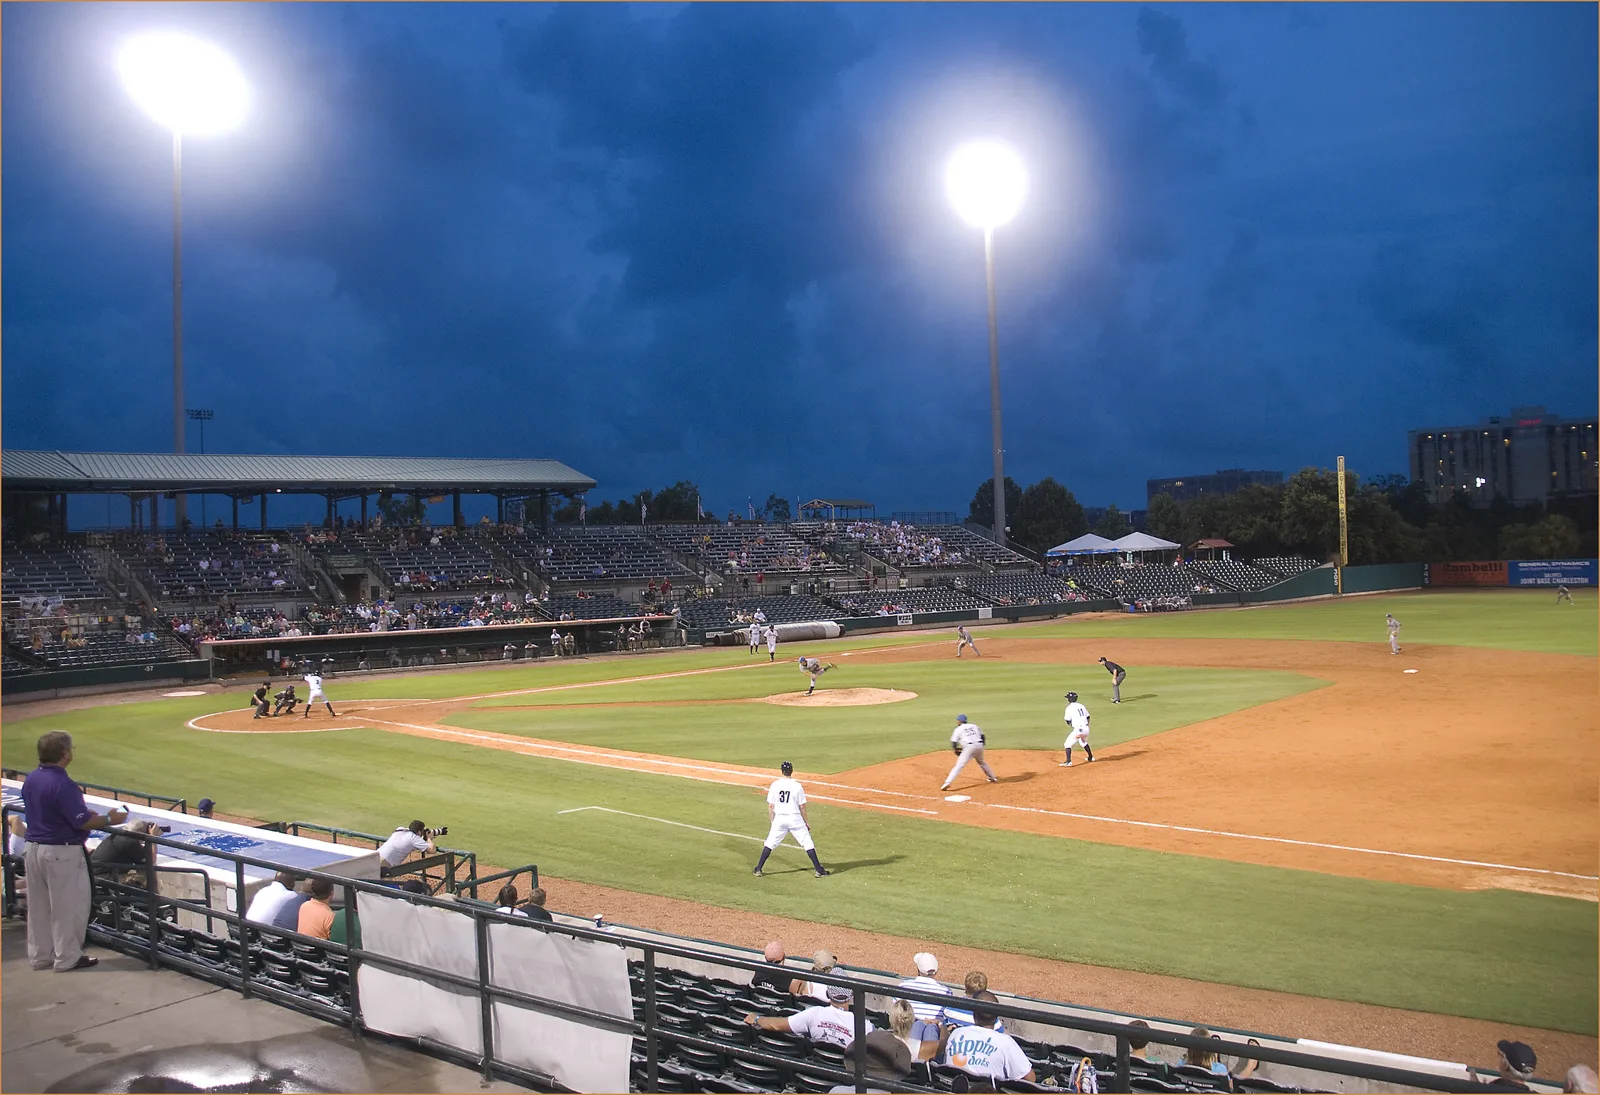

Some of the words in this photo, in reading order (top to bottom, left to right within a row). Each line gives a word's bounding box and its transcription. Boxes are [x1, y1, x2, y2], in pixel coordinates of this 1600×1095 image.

[1442, 562, 1504, 572] Zambelli
[779, 790, 791, 804] 37
[968, 1055, 990, 1067] dots
